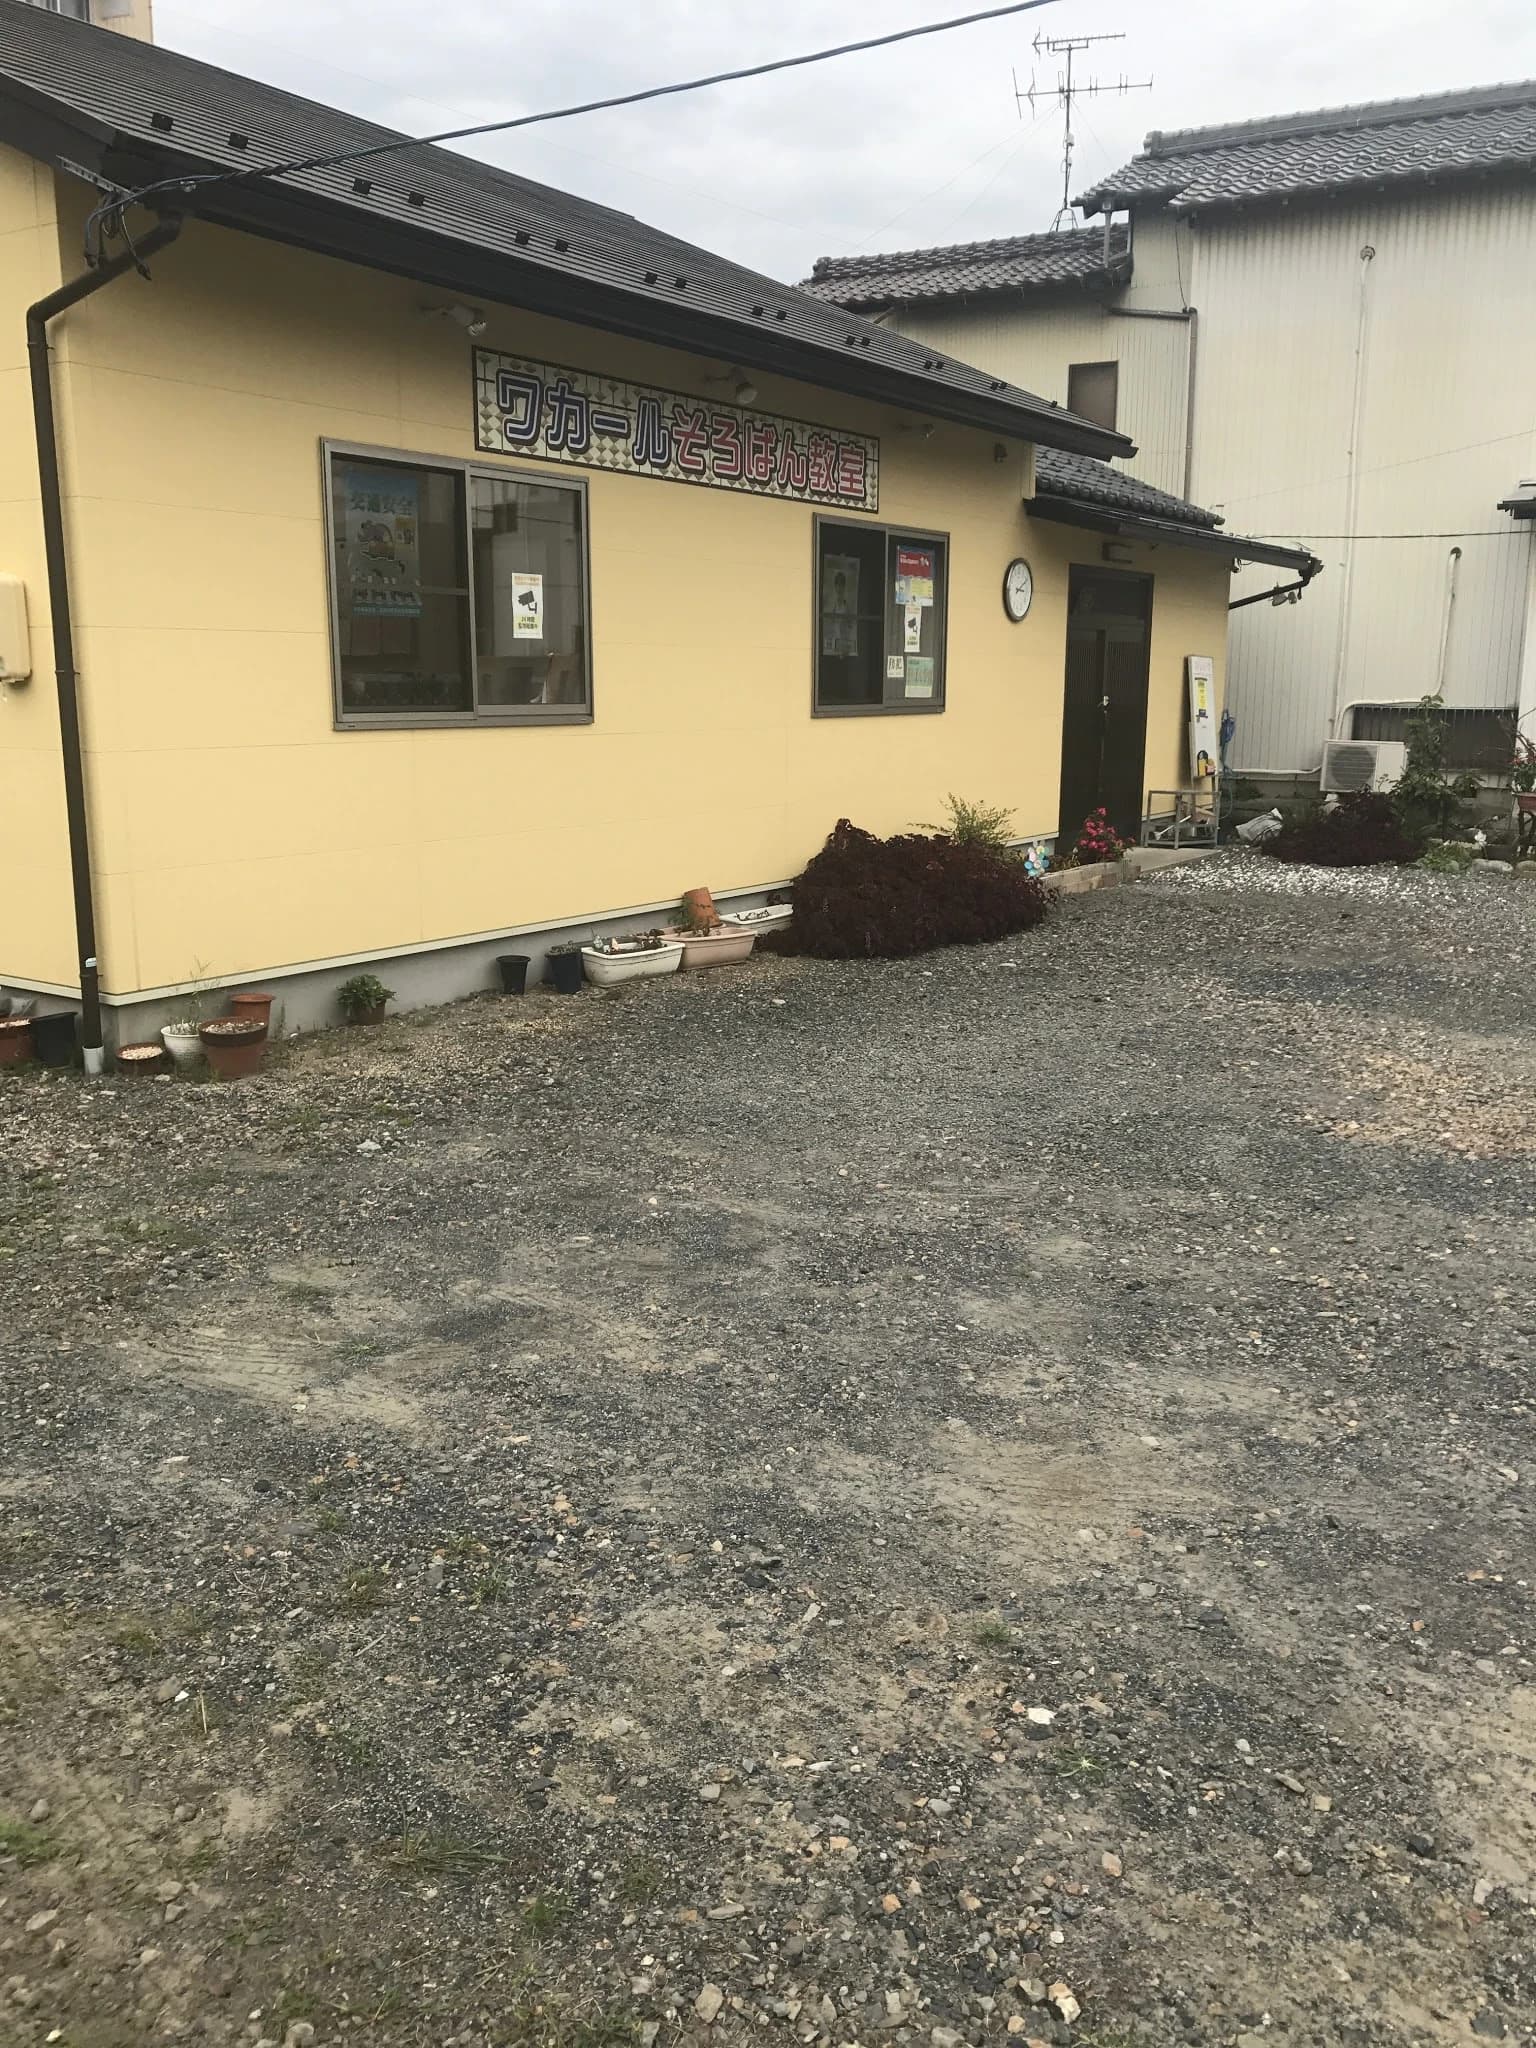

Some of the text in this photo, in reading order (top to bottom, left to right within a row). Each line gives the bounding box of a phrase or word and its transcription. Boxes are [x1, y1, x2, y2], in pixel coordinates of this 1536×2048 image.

[496, 367, 866, 499] ワカールそろばん教室
